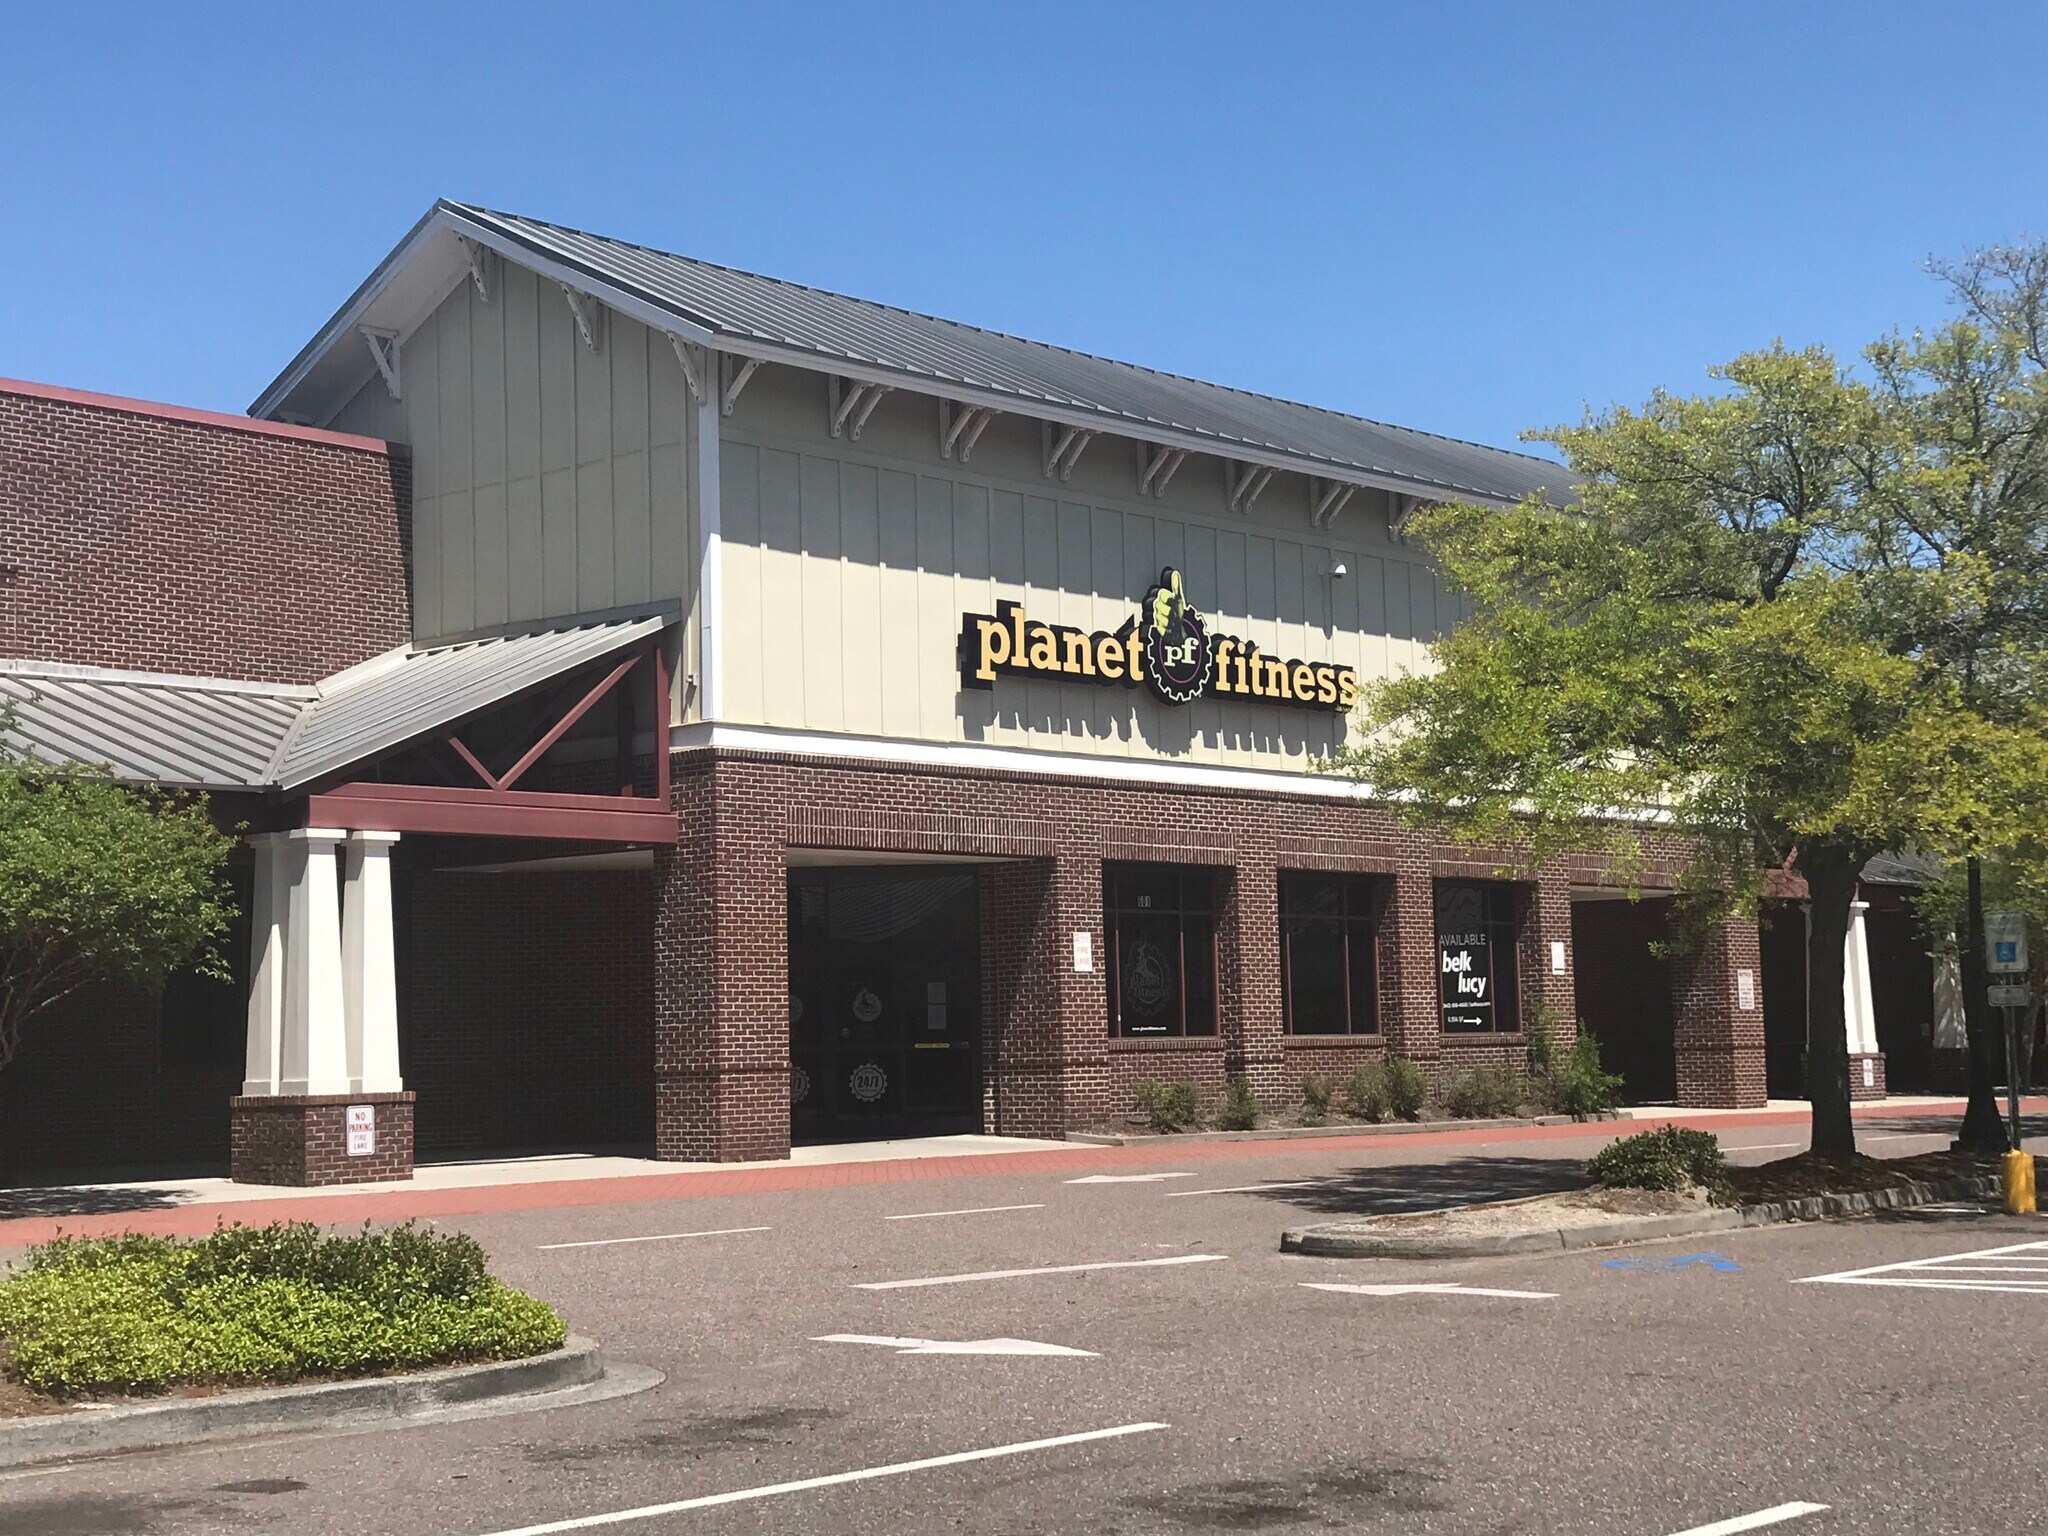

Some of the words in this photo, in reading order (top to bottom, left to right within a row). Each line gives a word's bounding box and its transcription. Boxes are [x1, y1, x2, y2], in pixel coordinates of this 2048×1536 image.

[975, 607, 1145, 682] planet
[1164, 638, 1199, 667] pf
[1215, 640, 1359, 706] fitness
[1439, 934, 1487, 946] AVAILABLE
[1442, 950, 1472, 973] belk
[1130, 974, 1160, 987] planet
[1457, 971, 1487, 998] lucy
[1134, 986, 1168, 997] fitness
[857, 1075, 880, 1089] 24/7
[355, 1111, 366, 1121] NO
[348, 1123, 373, 1133] PARKING
[353, 1142, 368, 1150] LANE
